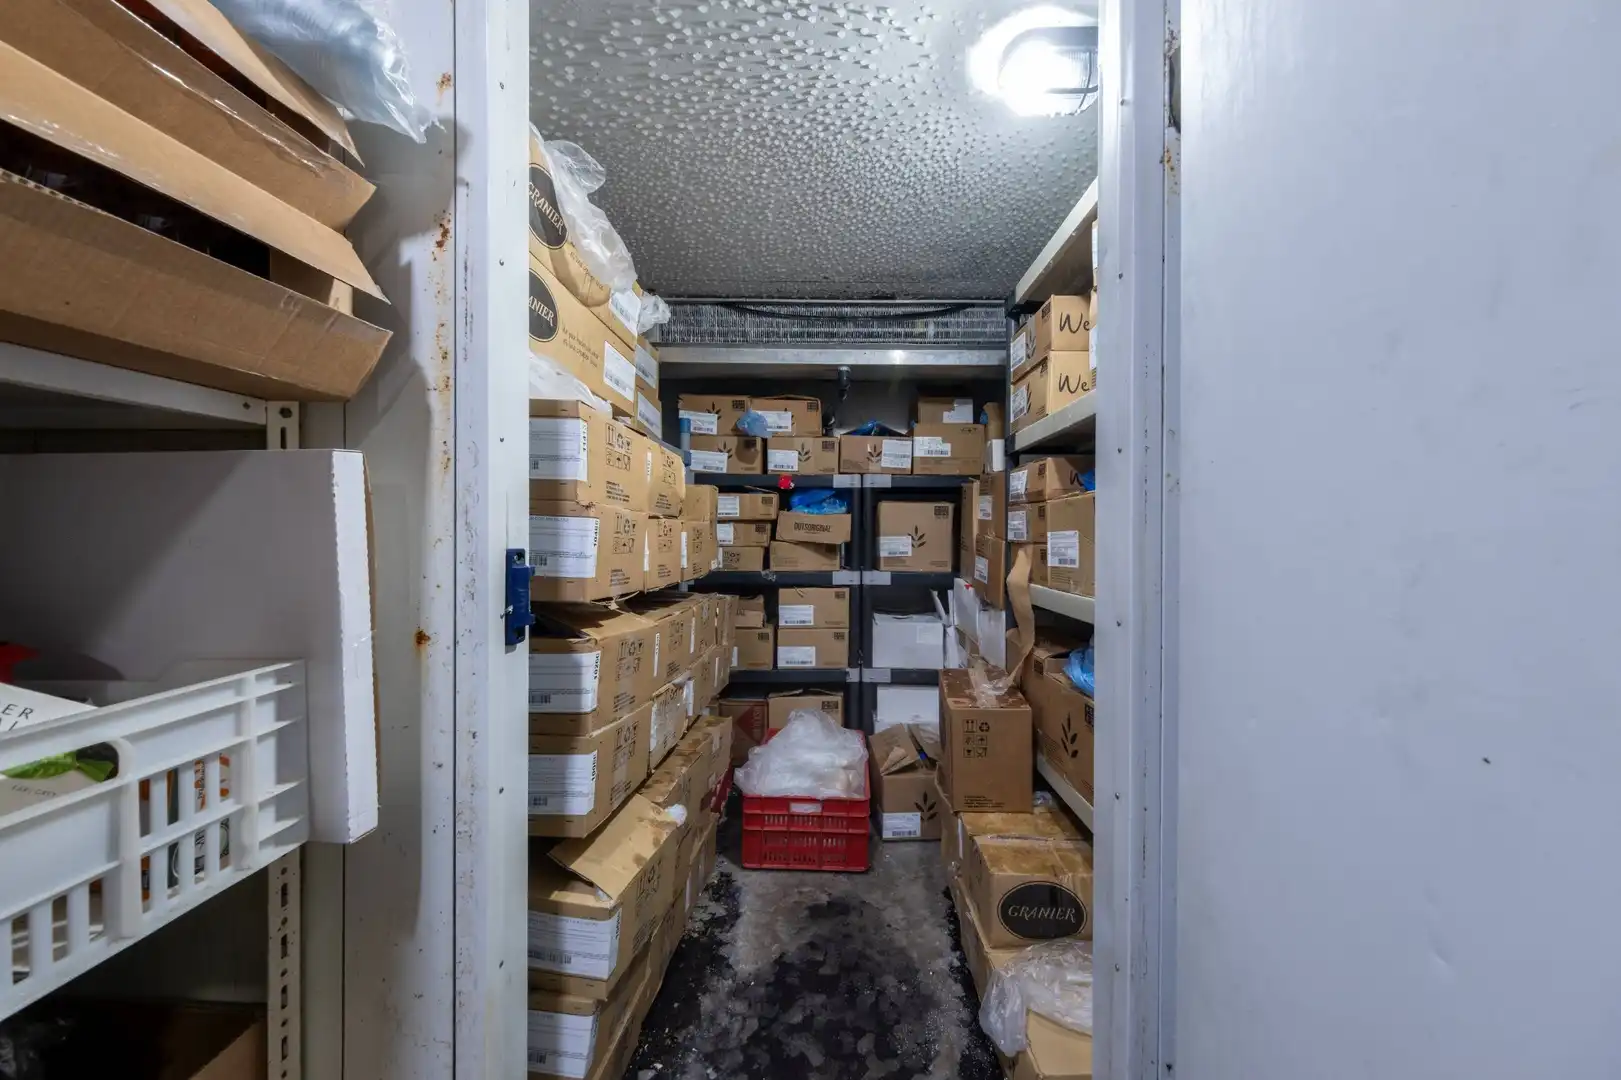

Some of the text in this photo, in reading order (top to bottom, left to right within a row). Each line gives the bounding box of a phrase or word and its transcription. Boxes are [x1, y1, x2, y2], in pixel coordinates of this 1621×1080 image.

[1059, 312, 1091, 334] We
[1058, 372, 1090, 394] We
[1008, 905, 1076, 923] GRANIER
